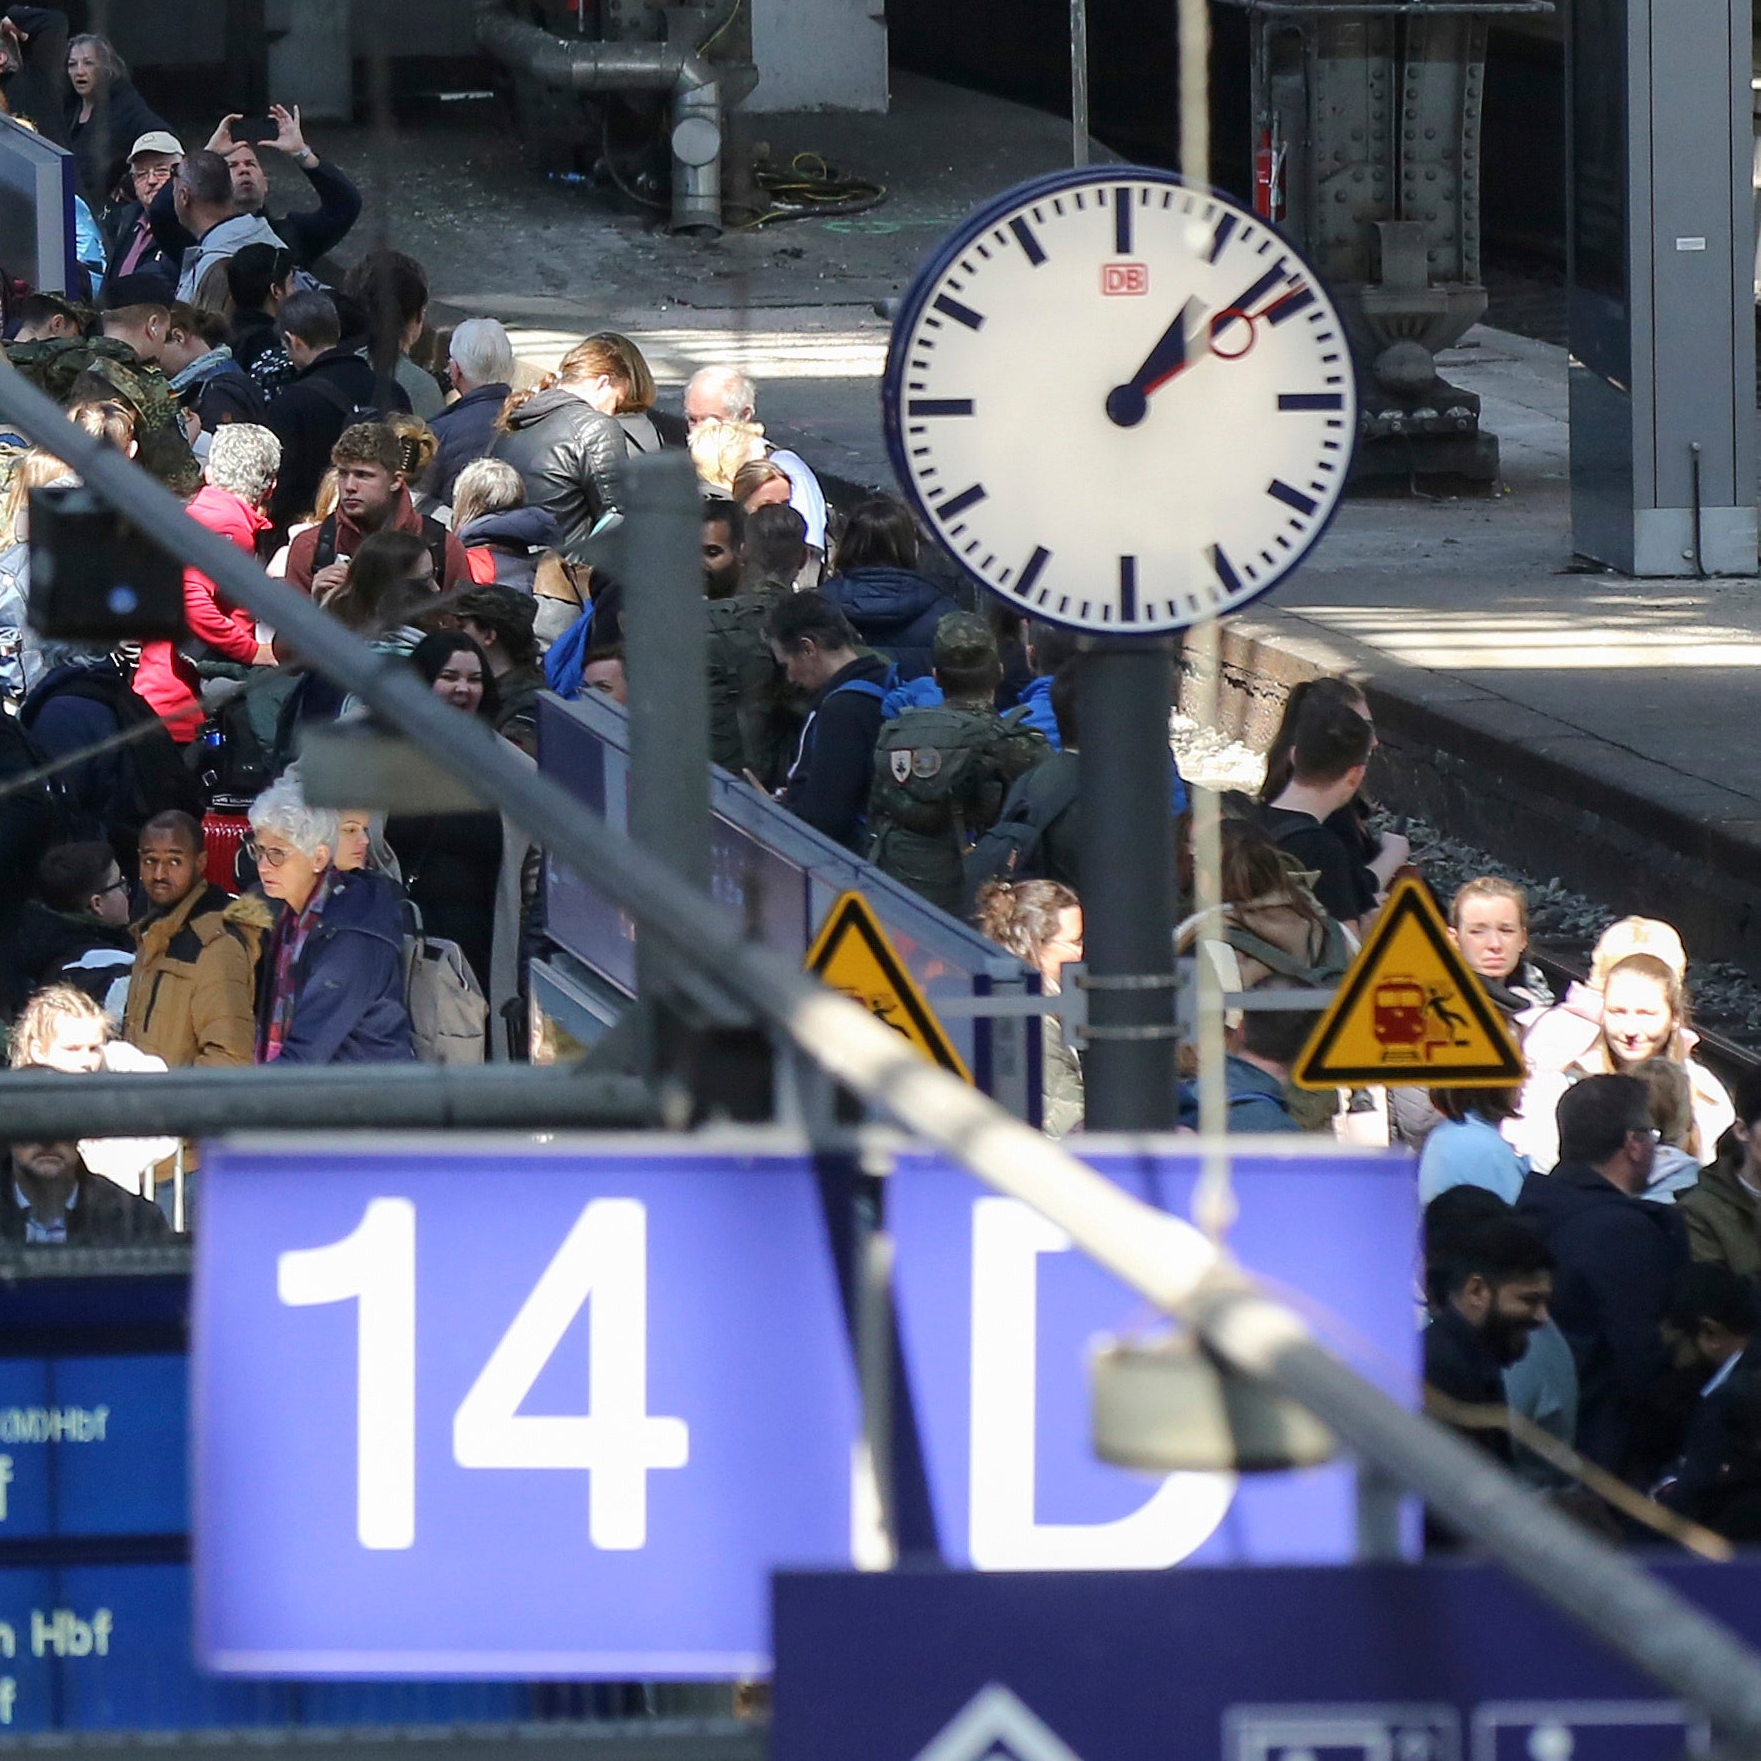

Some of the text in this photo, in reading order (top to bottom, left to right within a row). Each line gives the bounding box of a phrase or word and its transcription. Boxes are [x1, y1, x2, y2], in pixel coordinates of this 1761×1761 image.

[1106, 269, 1142, 290] DB
[277, 1198, 689, 1551] 14
[32, 1610, 113, 1657] Hbf
